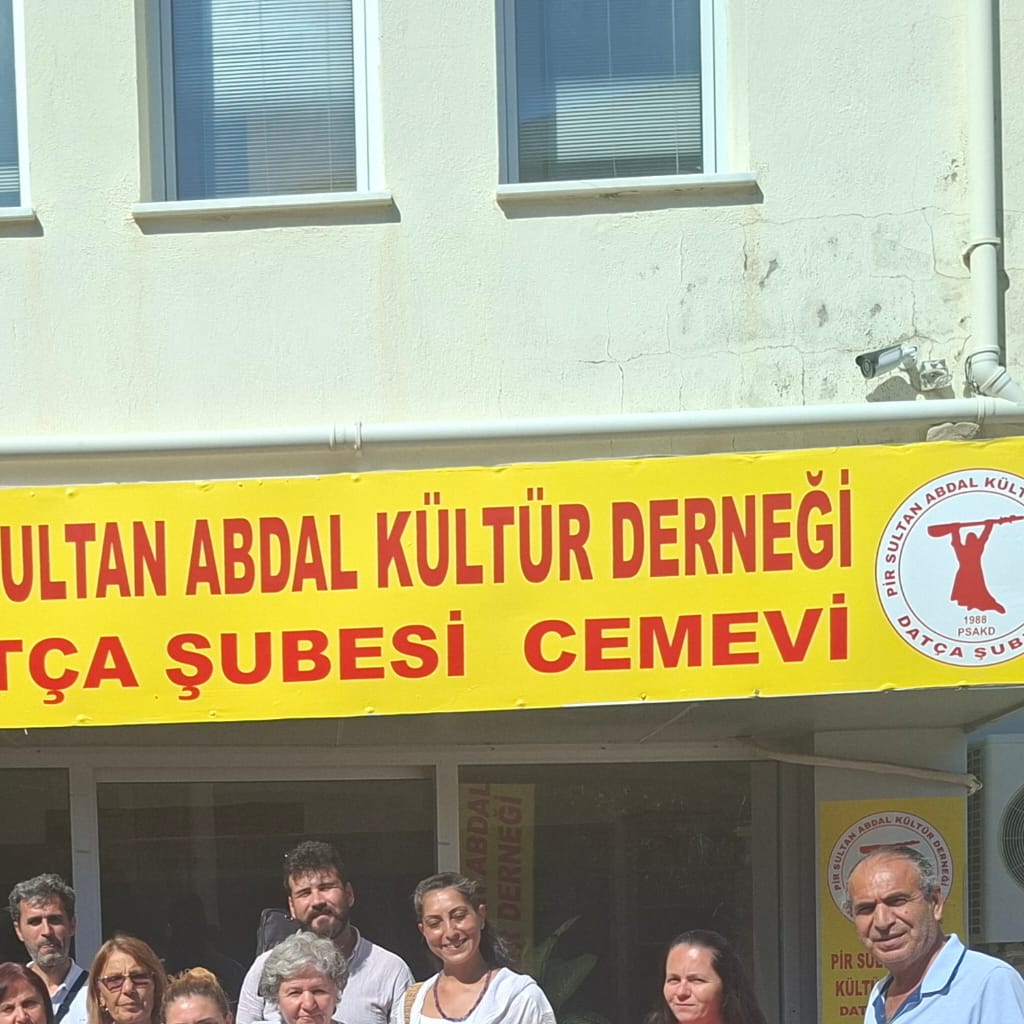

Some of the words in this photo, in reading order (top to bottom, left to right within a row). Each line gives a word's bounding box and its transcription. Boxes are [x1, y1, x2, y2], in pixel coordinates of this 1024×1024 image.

[925, 477, 978, 504] ABDAL
[186, 512, 358, 597] ABDAL
[377, 487, 593, 589] KÜLTÜR
[612, 469, 852, 579] DERNEĞİ
[885, 502, 923, 563] SULTAN
[882, 569, 898, 597] PİR
[958, 627, 995, 636] PSAKD
[964, 615, 987, 624] 1988
[166, 610, 465, 701] ŞUBESİ
[524, 593, 849, 674] CEMEVİ
[897, 615, 964, 658] DATÇA
[834, 832, 856, 870] SULTAN
[857, 817, 891, 834] ABDAL
[895, 816, 934, 841] KÜLTÜR
[831, 950, 853, 970] PİR
[840, 1006, 867, 1016] DAT
